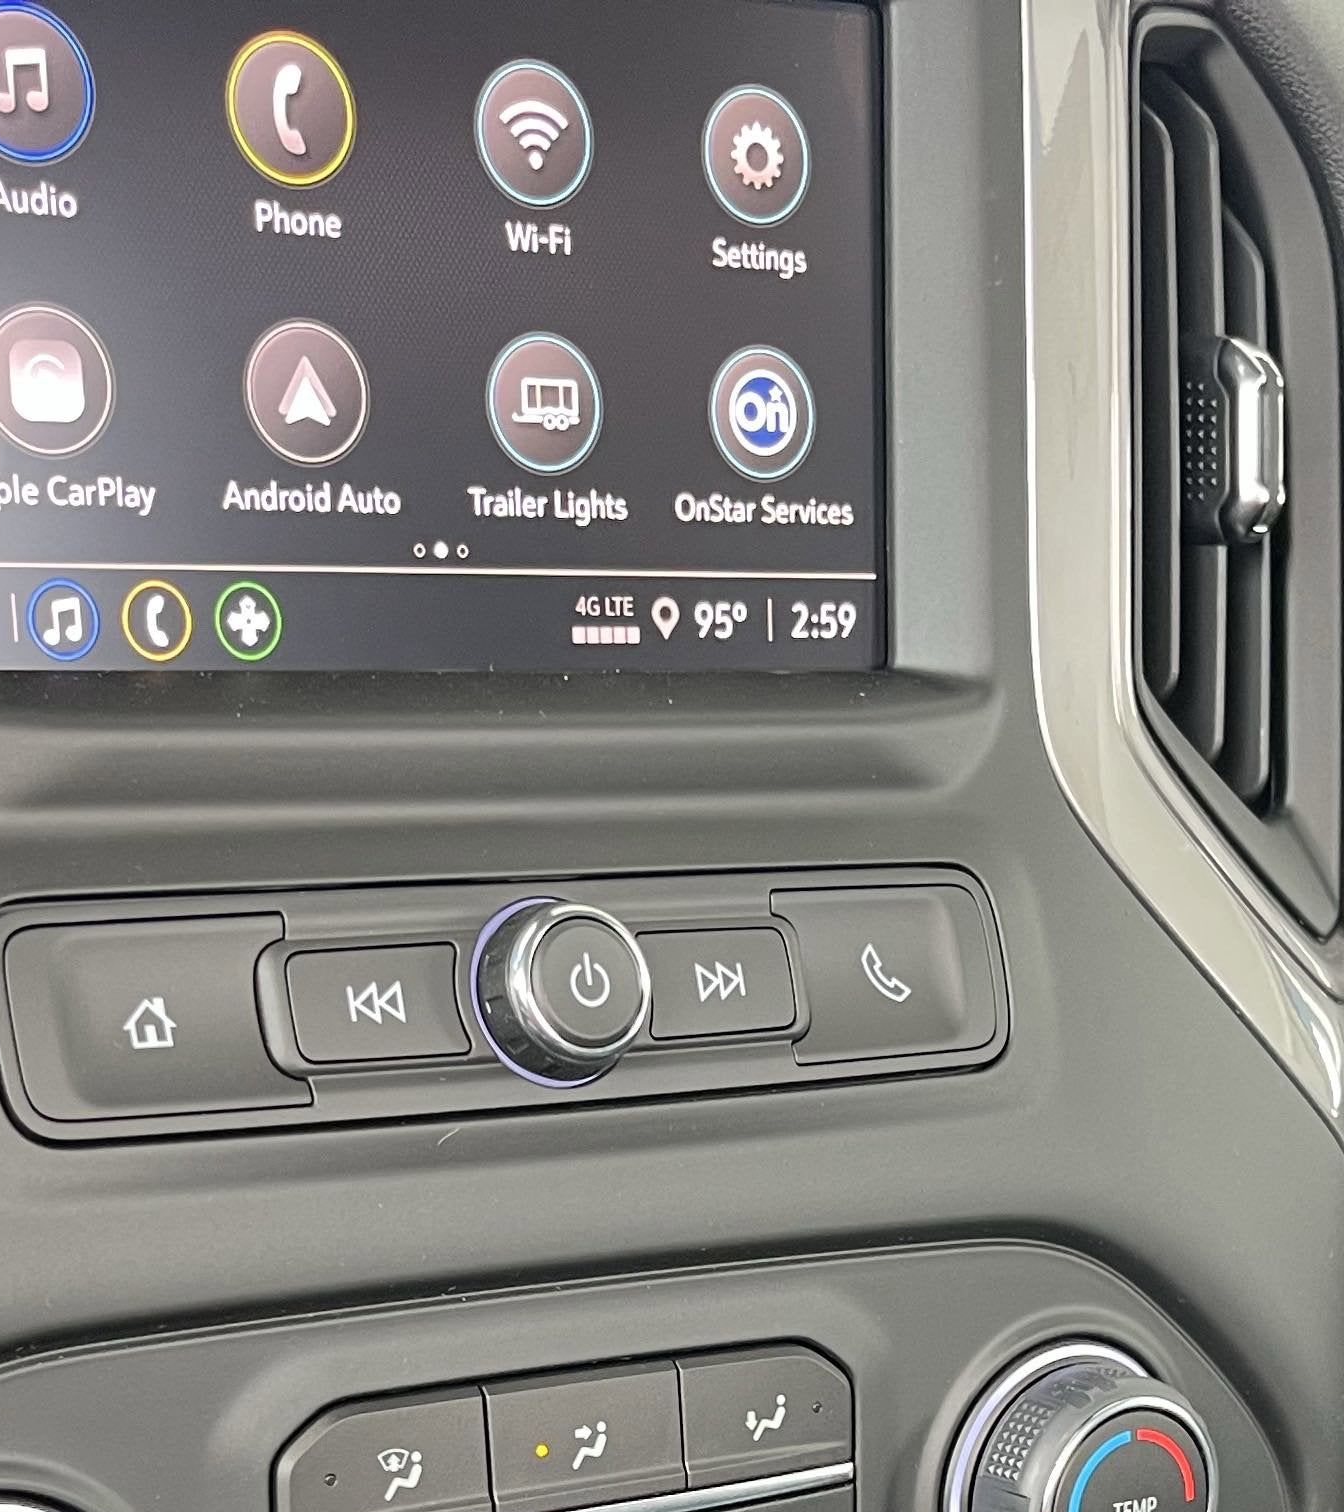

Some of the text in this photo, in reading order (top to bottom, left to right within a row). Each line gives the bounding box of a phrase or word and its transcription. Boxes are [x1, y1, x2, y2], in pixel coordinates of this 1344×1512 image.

[255, 201, 342, 239] Phone
[506, 222, 572, 256] Wi-Fi
[712, 238, 807, 279] Settings
[47, 476, 156, 516] CarPlay
[223, 482, 402, 515] Android Auto
[467, 486, 628, 528] Trailer Lights
[674, 493, 854, 527] OnStar Services
[575, 597, 634, 618] 4G LTE
[790, 602, 857, 640] 2:59
